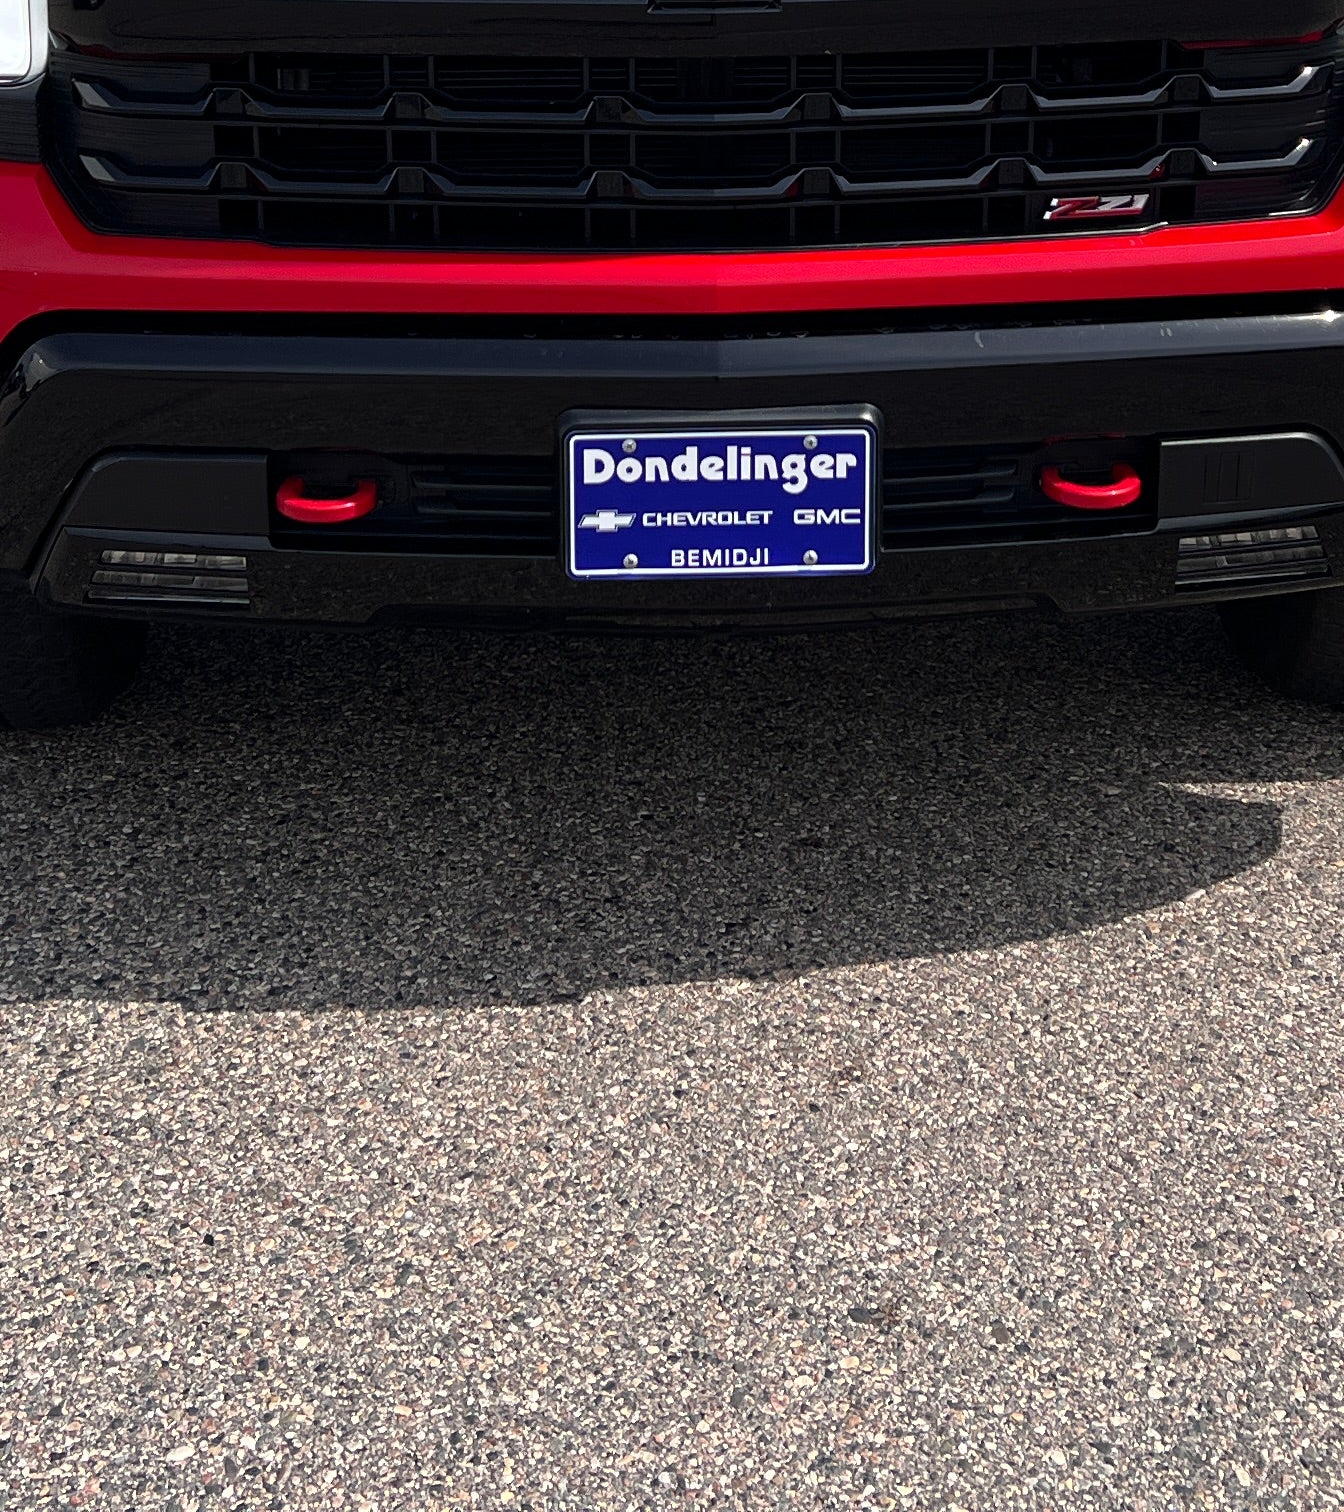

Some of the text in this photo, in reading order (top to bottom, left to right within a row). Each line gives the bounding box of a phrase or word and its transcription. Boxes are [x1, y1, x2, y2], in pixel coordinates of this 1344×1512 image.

[583, 445, 857, 494] Dondelinger
[642, 509, 861, 527] CHEVROLET GMC
[670, 548, 770, 567] BEMIDJI
